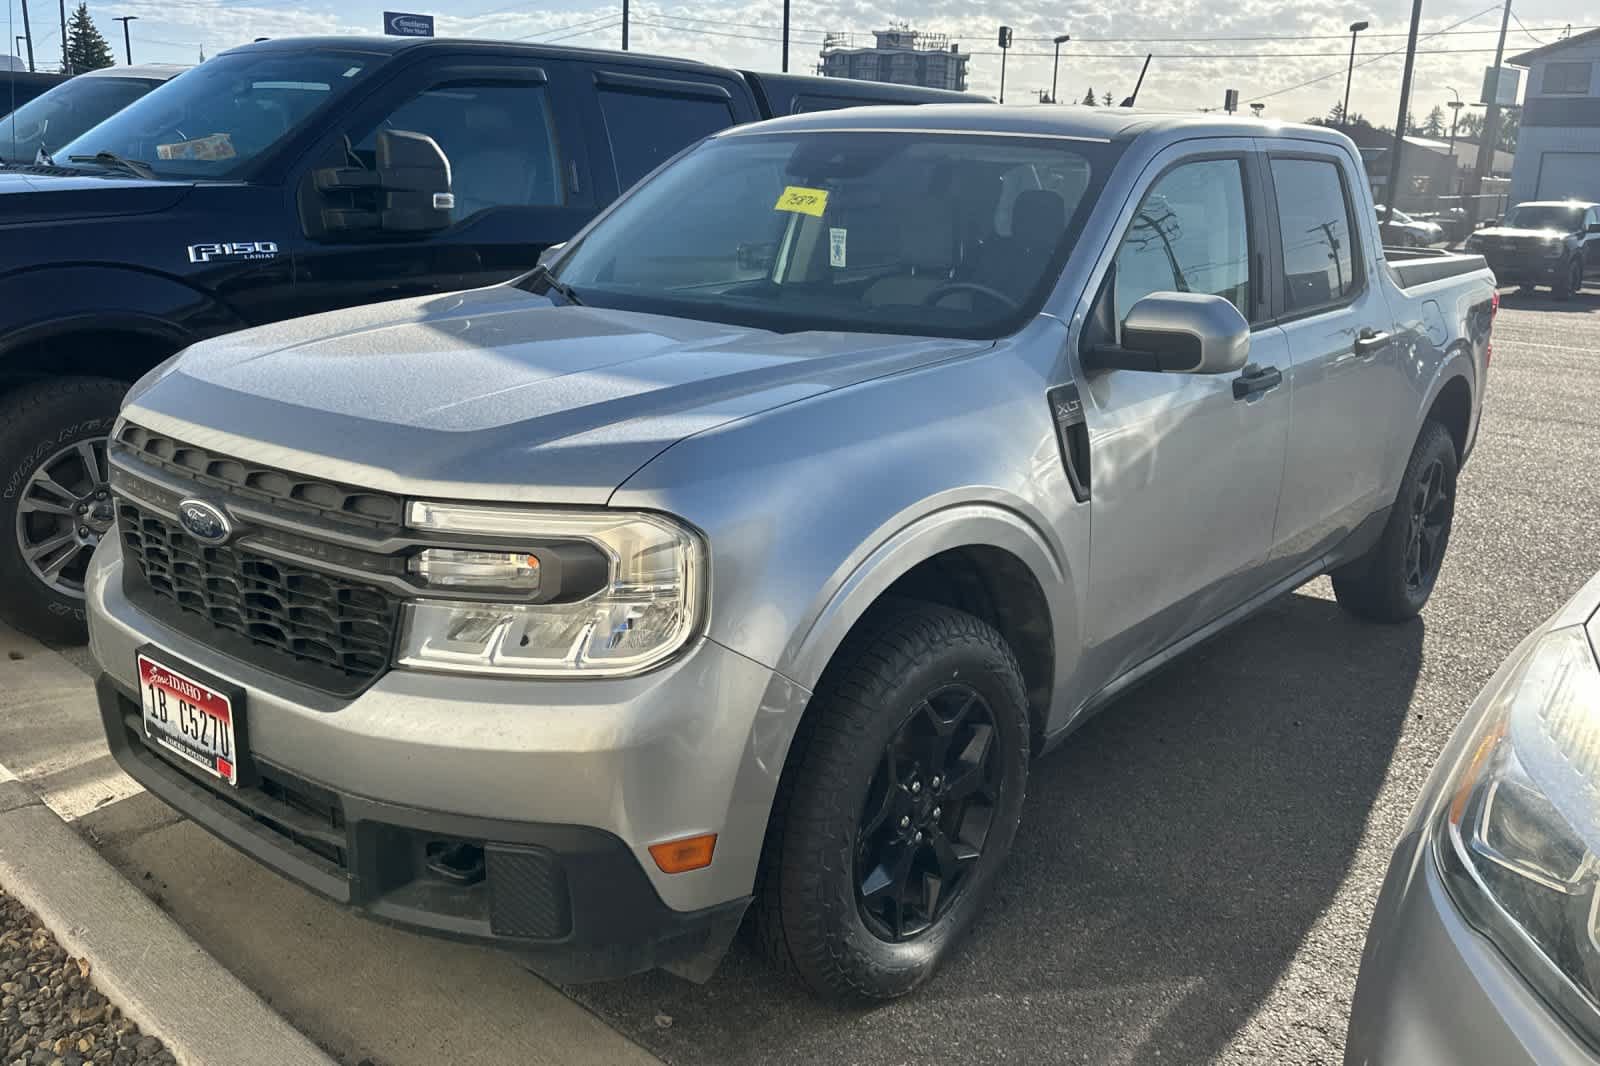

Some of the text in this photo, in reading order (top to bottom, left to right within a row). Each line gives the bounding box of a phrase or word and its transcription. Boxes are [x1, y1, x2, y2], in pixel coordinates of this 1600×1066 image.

[1058, 400, 1081, 415] XLT
[169, 674, 201, 702] IDAHO
[149, 682, 168, 724] 1B
